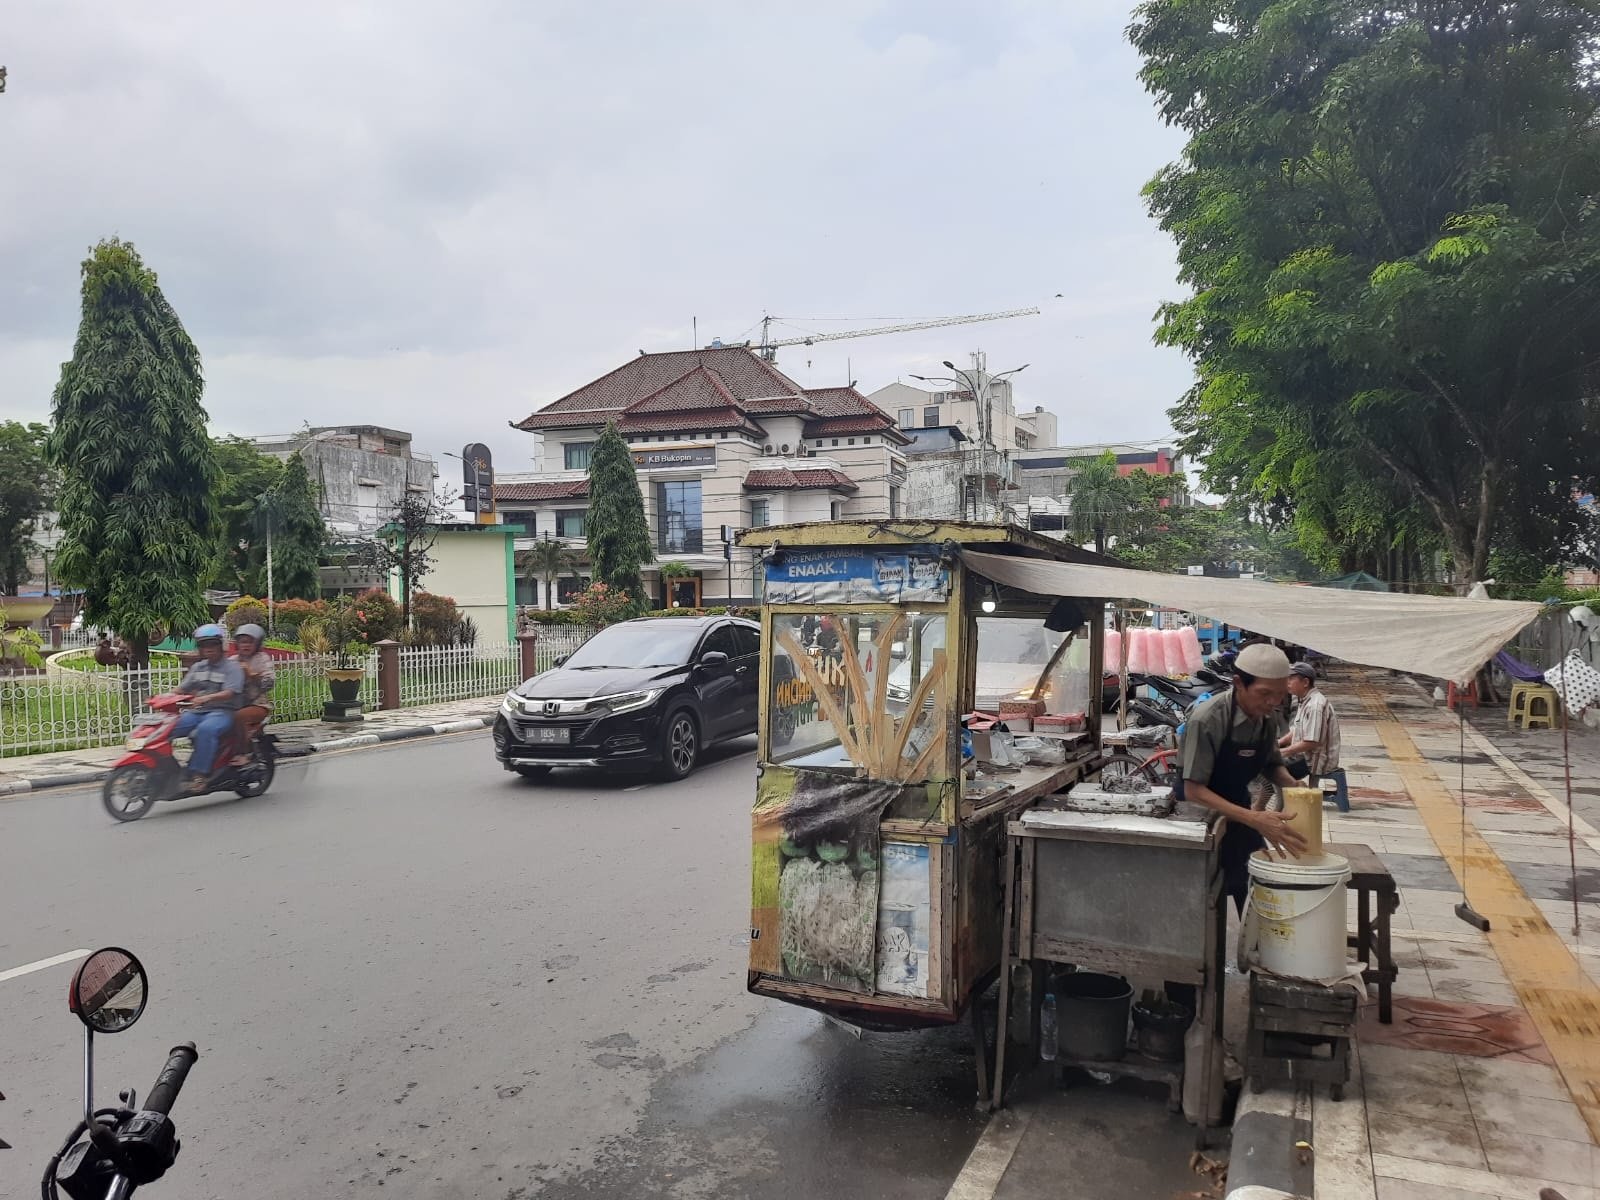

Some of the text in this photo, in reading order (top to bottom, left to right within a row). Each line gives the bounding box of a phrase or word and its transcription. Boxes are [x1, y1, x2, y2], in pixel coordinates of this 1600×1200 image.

[648, 455, 660, 463] KB
[661, 454, 692, 463] Bukopin
[799, 552, 824, 563] ENAK
[788, 560, 847, 578] ENAAK..!
